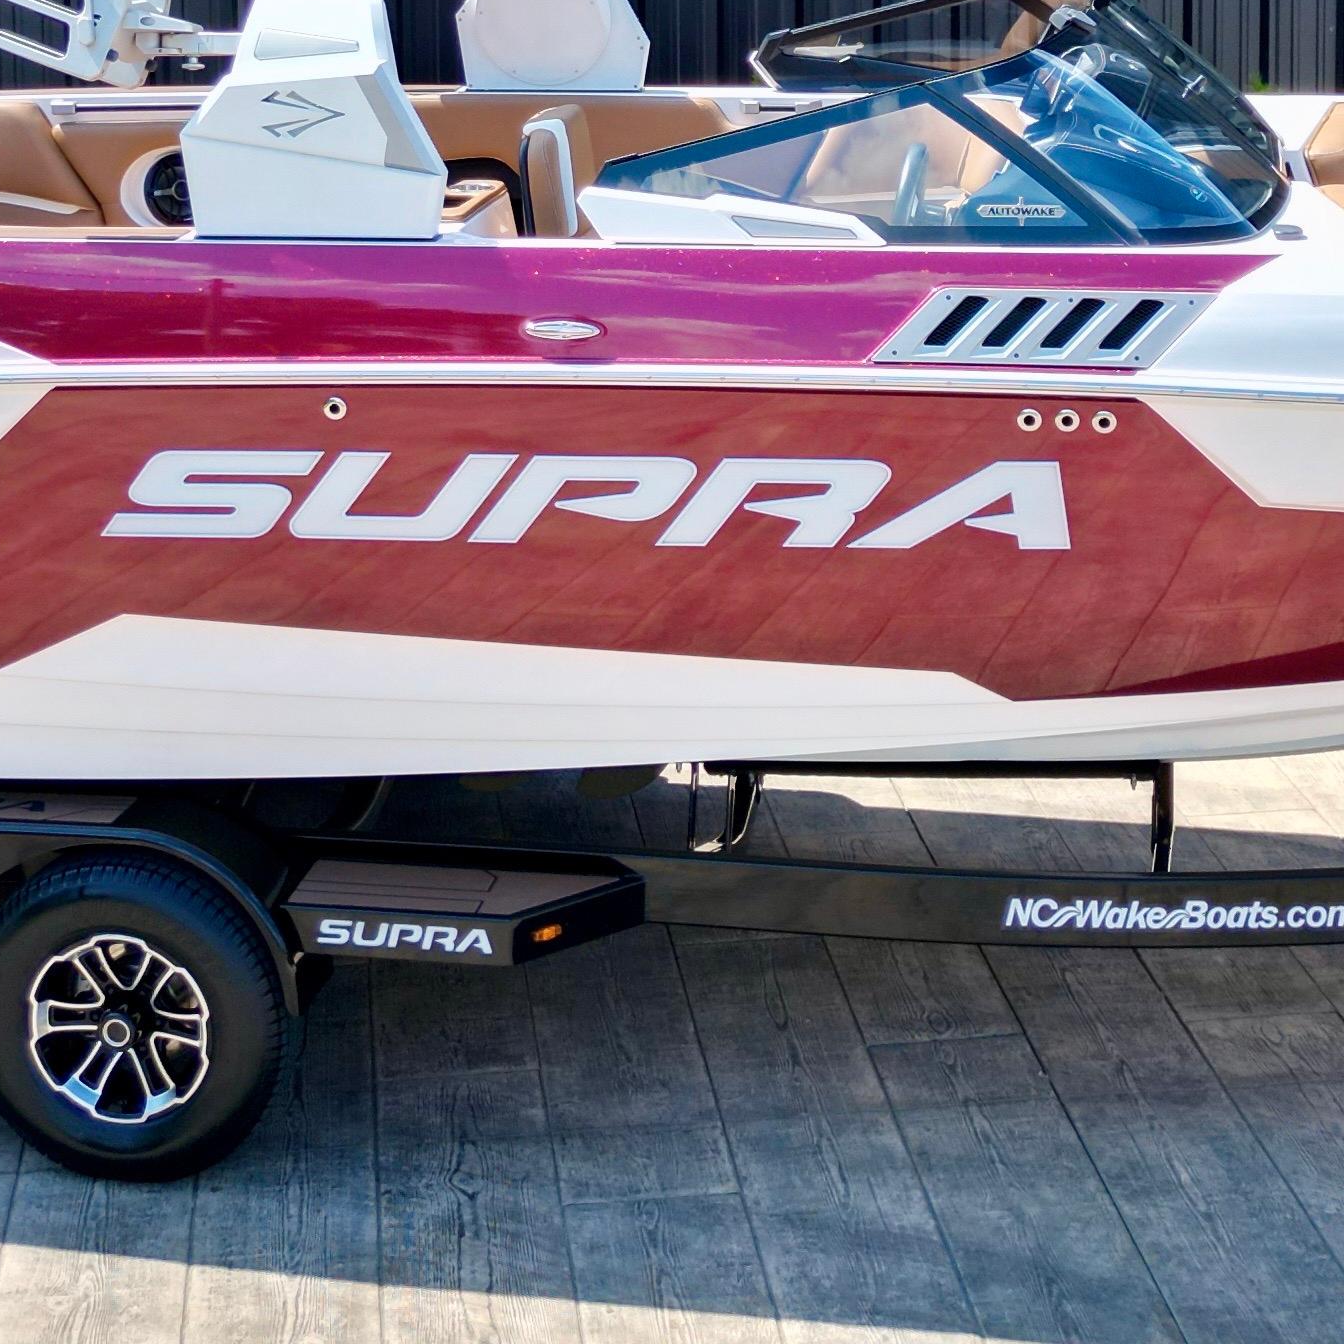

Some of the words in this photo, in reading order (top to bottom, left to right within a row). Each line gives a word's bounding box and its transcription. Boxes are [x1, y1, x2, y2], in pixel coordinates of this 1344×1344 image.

[987, 207, 1056, 217] AUTOWAKE
[100, 450, 1072, 550] SUPRA
[316, 919, 493, 955] SUPRA
